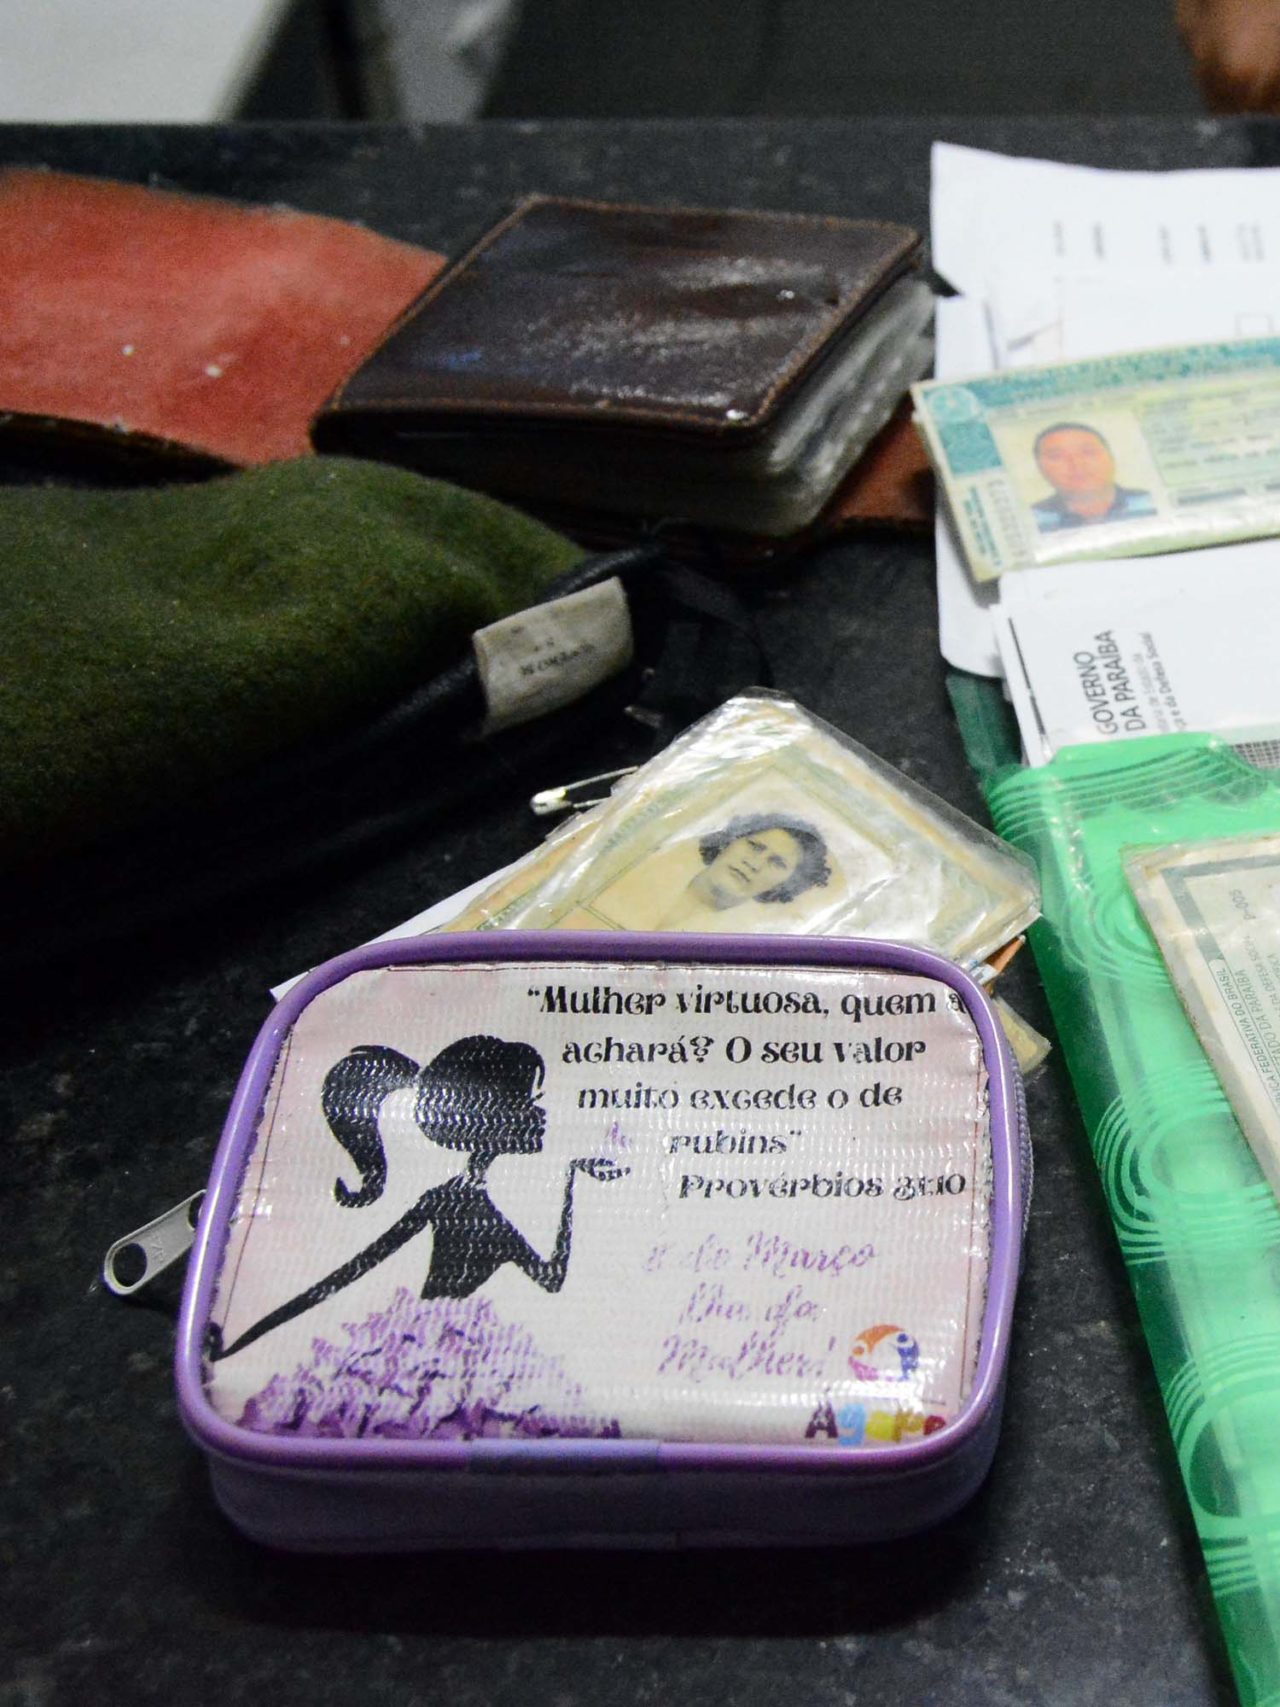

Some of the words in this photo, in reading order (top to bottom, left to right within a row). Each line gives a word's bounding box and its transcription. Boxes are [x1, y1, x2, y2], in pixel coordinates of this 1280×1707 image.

[1073, 652, 1118, 734] GOVERNO
[1121, 706, 1146, 731] DA
[1213, 967, 1239, 1000] BRASIL
[675, 984, 830, 1016] virtuosa,
[841, 990, 936, 1023] quem
[1229, 1001, 1246, 1016] DO
[1252, 1013, 1273, 1030] DA
[726, 1036, 752, 1063] O
[761, 1041, 823, 1064] seu
[834, 1037, 927, 1063] valor
[1236, 1016, 1274, 1073] FEDERATIVA
[578, 1081, 679, 1110] muito
[690, 1085, 817, 1110] excede
[827, 1090, 849, 1109] o
[859, 1081, 903, 1109] de
